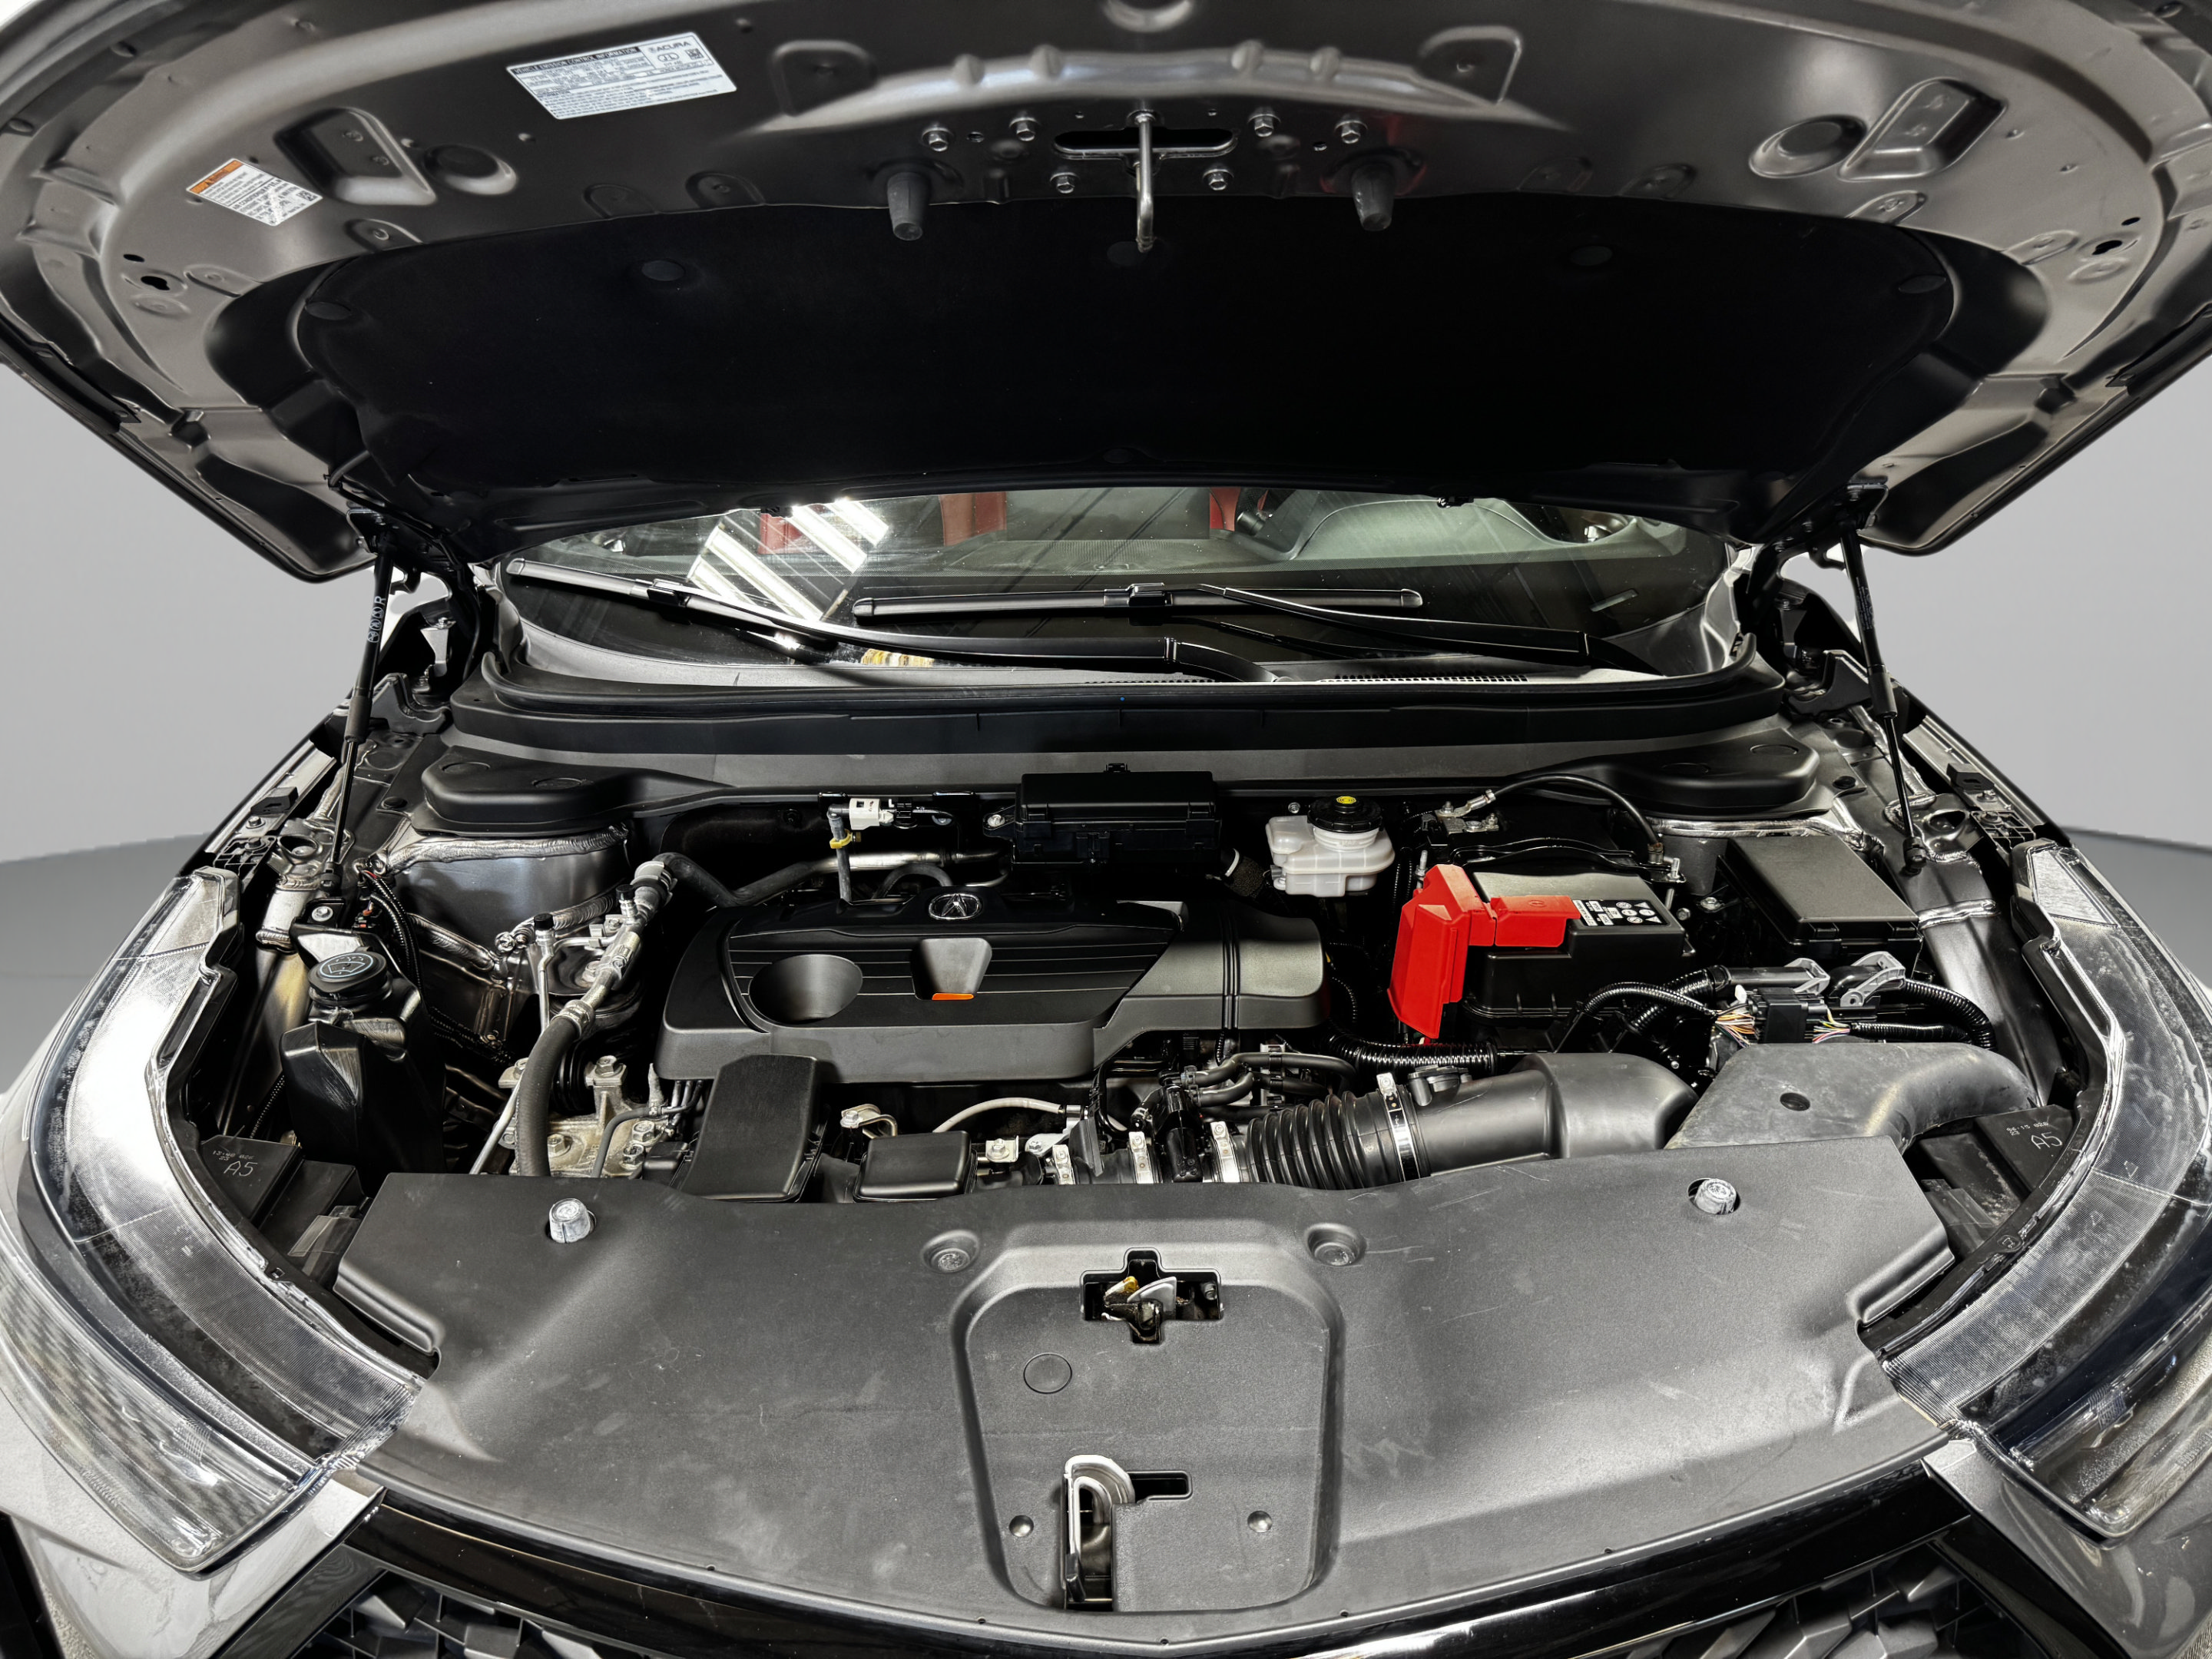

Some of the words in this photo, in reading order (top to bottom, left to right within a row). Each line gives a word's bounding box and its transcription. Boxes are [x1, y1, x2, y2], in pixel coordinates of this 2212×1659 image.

[654, 41, 691, 51] ACURA
[514, 65, 539, 74] VEHICLE
[567, 55, 597, 64] CONTROL
[595, 47, 637, 59] INFORMATION
[2031, 1131, 2062, 1149] A5
[224, 1161, 258, 1176] A5
